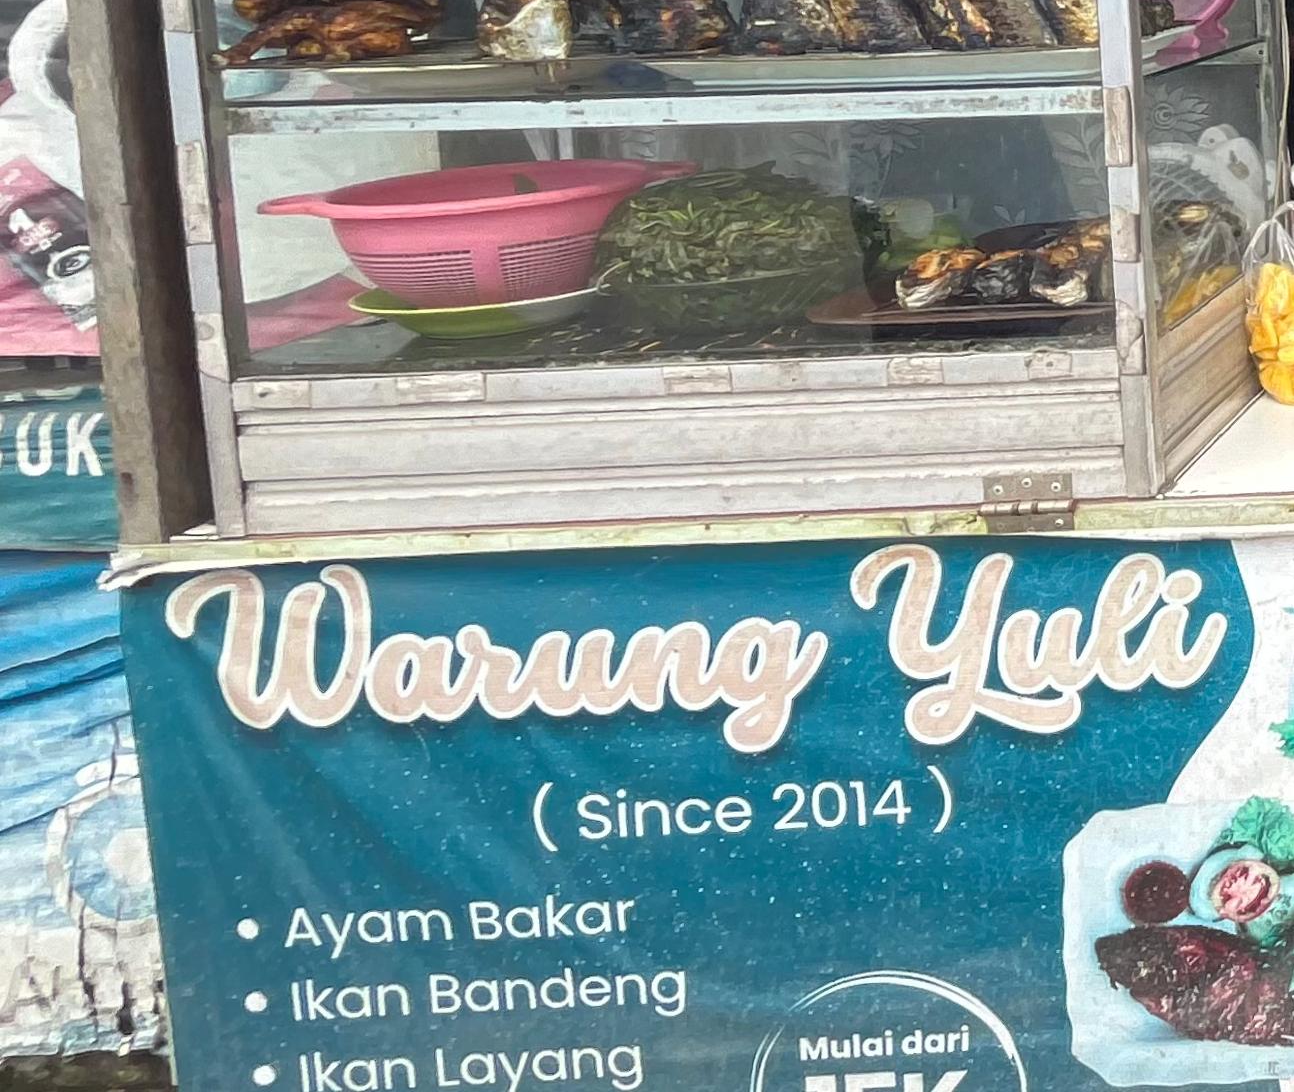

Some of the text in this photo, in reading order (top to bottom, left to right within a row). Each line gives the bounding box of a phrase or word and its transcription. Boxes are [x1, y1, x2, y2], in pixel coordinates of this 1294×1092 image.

[0, 411, 105, 477] UK
[165, 543, 1227, 754] Warung Yuli
[578, 789, 752, 841] Since
[772, 779, 911, 833] 2014
[285, 893, 634, 959] Ayam Bakar
[291, 968, 687, 1022] Ikan Bandeng
[300, 1044, 644, 1092] Ikan Layang
[799, 1024, 970, 1061] Mulai dari
